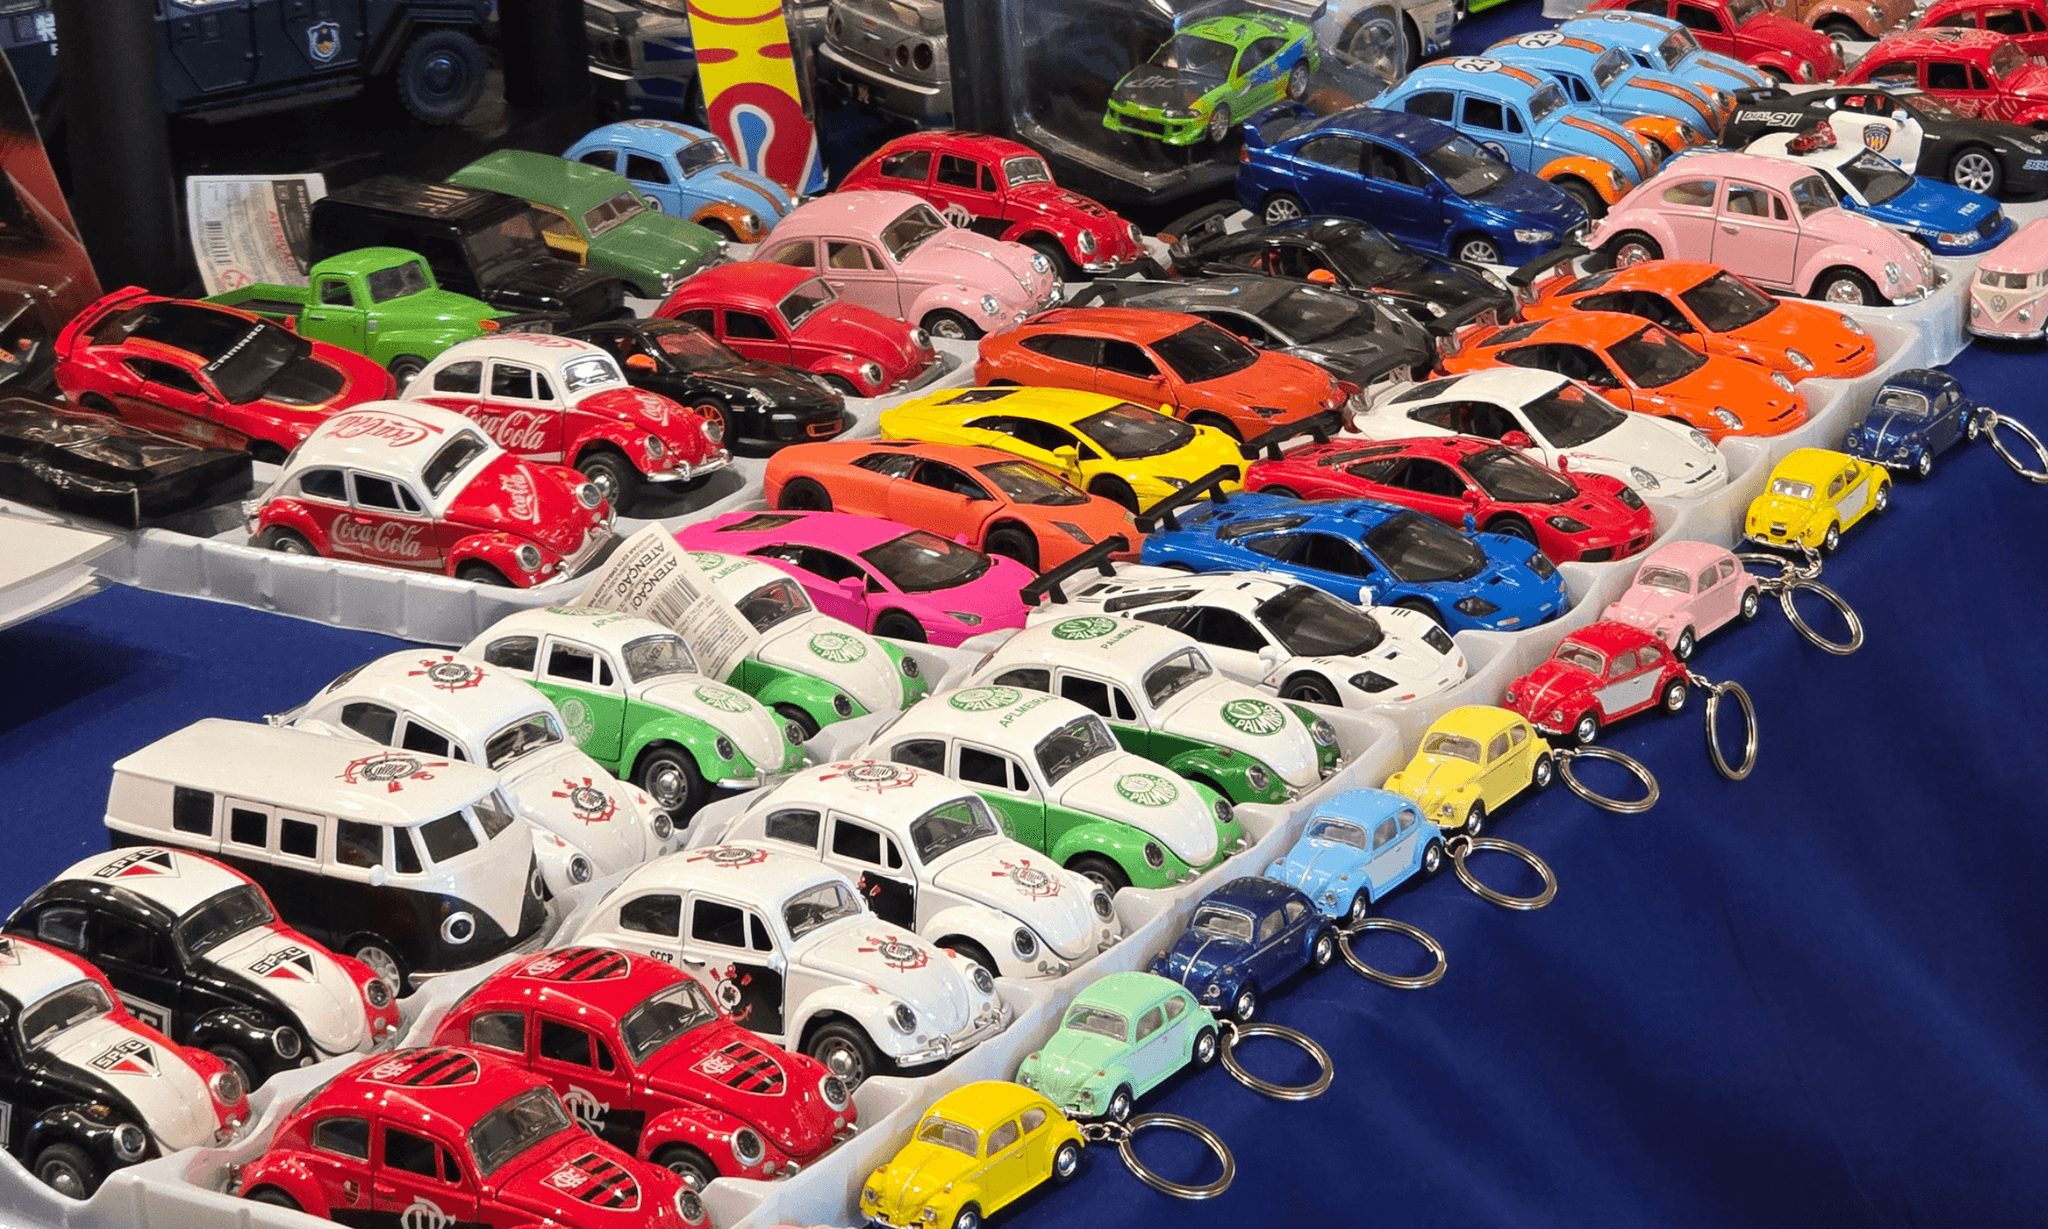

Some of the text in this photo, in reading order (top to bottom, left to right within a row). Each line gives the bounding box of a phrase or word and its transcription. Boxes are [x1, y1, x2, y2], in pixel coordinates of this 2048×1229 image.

[1525, 33, 1557, 46] 23
[1462, 58, 1494, 71] 23
[1742, 111, 1802, 127] DIAL 911
[1916, 227, 1940, 237] POLICE
[208, 324, 266, 371] CAMARO
[321, 414, 428, 447] Coca-Cola
[499, 472, 533, 520] Coca-Cola
[331, 513, 424, 557] Coca-Cola
[615, 542, 665, 598] ATENÇÃO!
[631, 556, 678, 610] ATENÇÃO!
[98, 848, 162, 877] SPFC
[252, 946, 302, 973] SPFC
[650, 950, 673, 963] SCCP
[95, 1040, 143, 1068] SPFC
